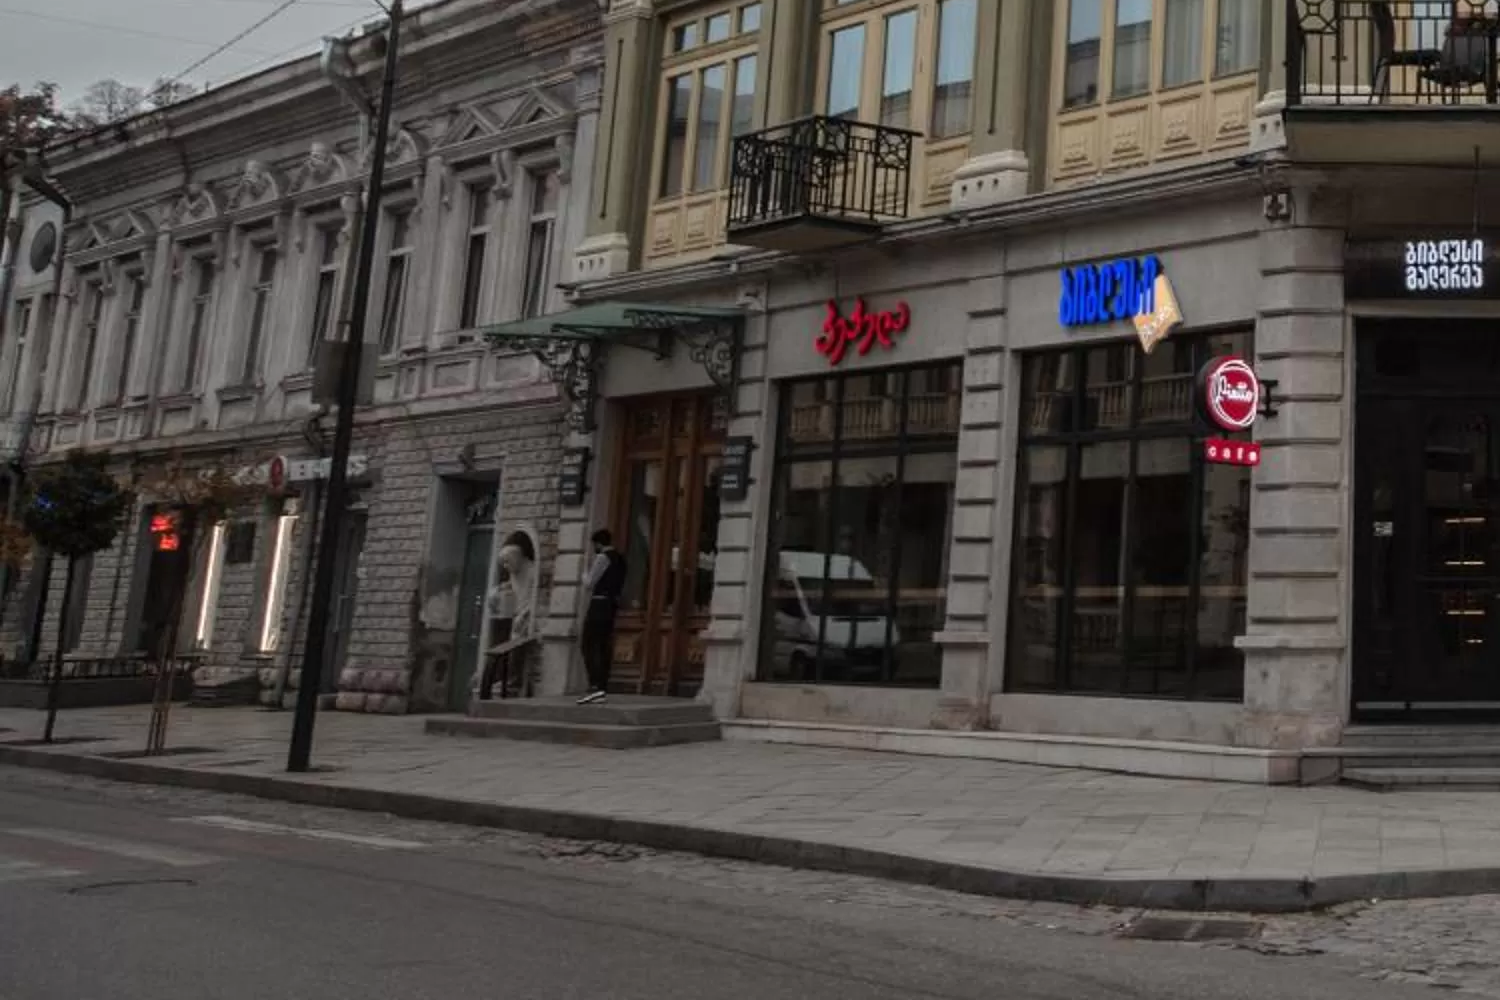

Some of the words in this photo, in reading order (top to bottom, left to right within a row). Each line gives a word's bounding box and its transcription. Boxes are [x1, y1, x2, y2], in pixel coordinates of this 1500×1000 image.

[1405, 239, 1483, 264] ბიბლუსი
[1405, 264, 1483, 290] გალერეა
[1059, 253, 1158, 327] ბიბლუსი
[1207, 446, 1258, 462] cafe
